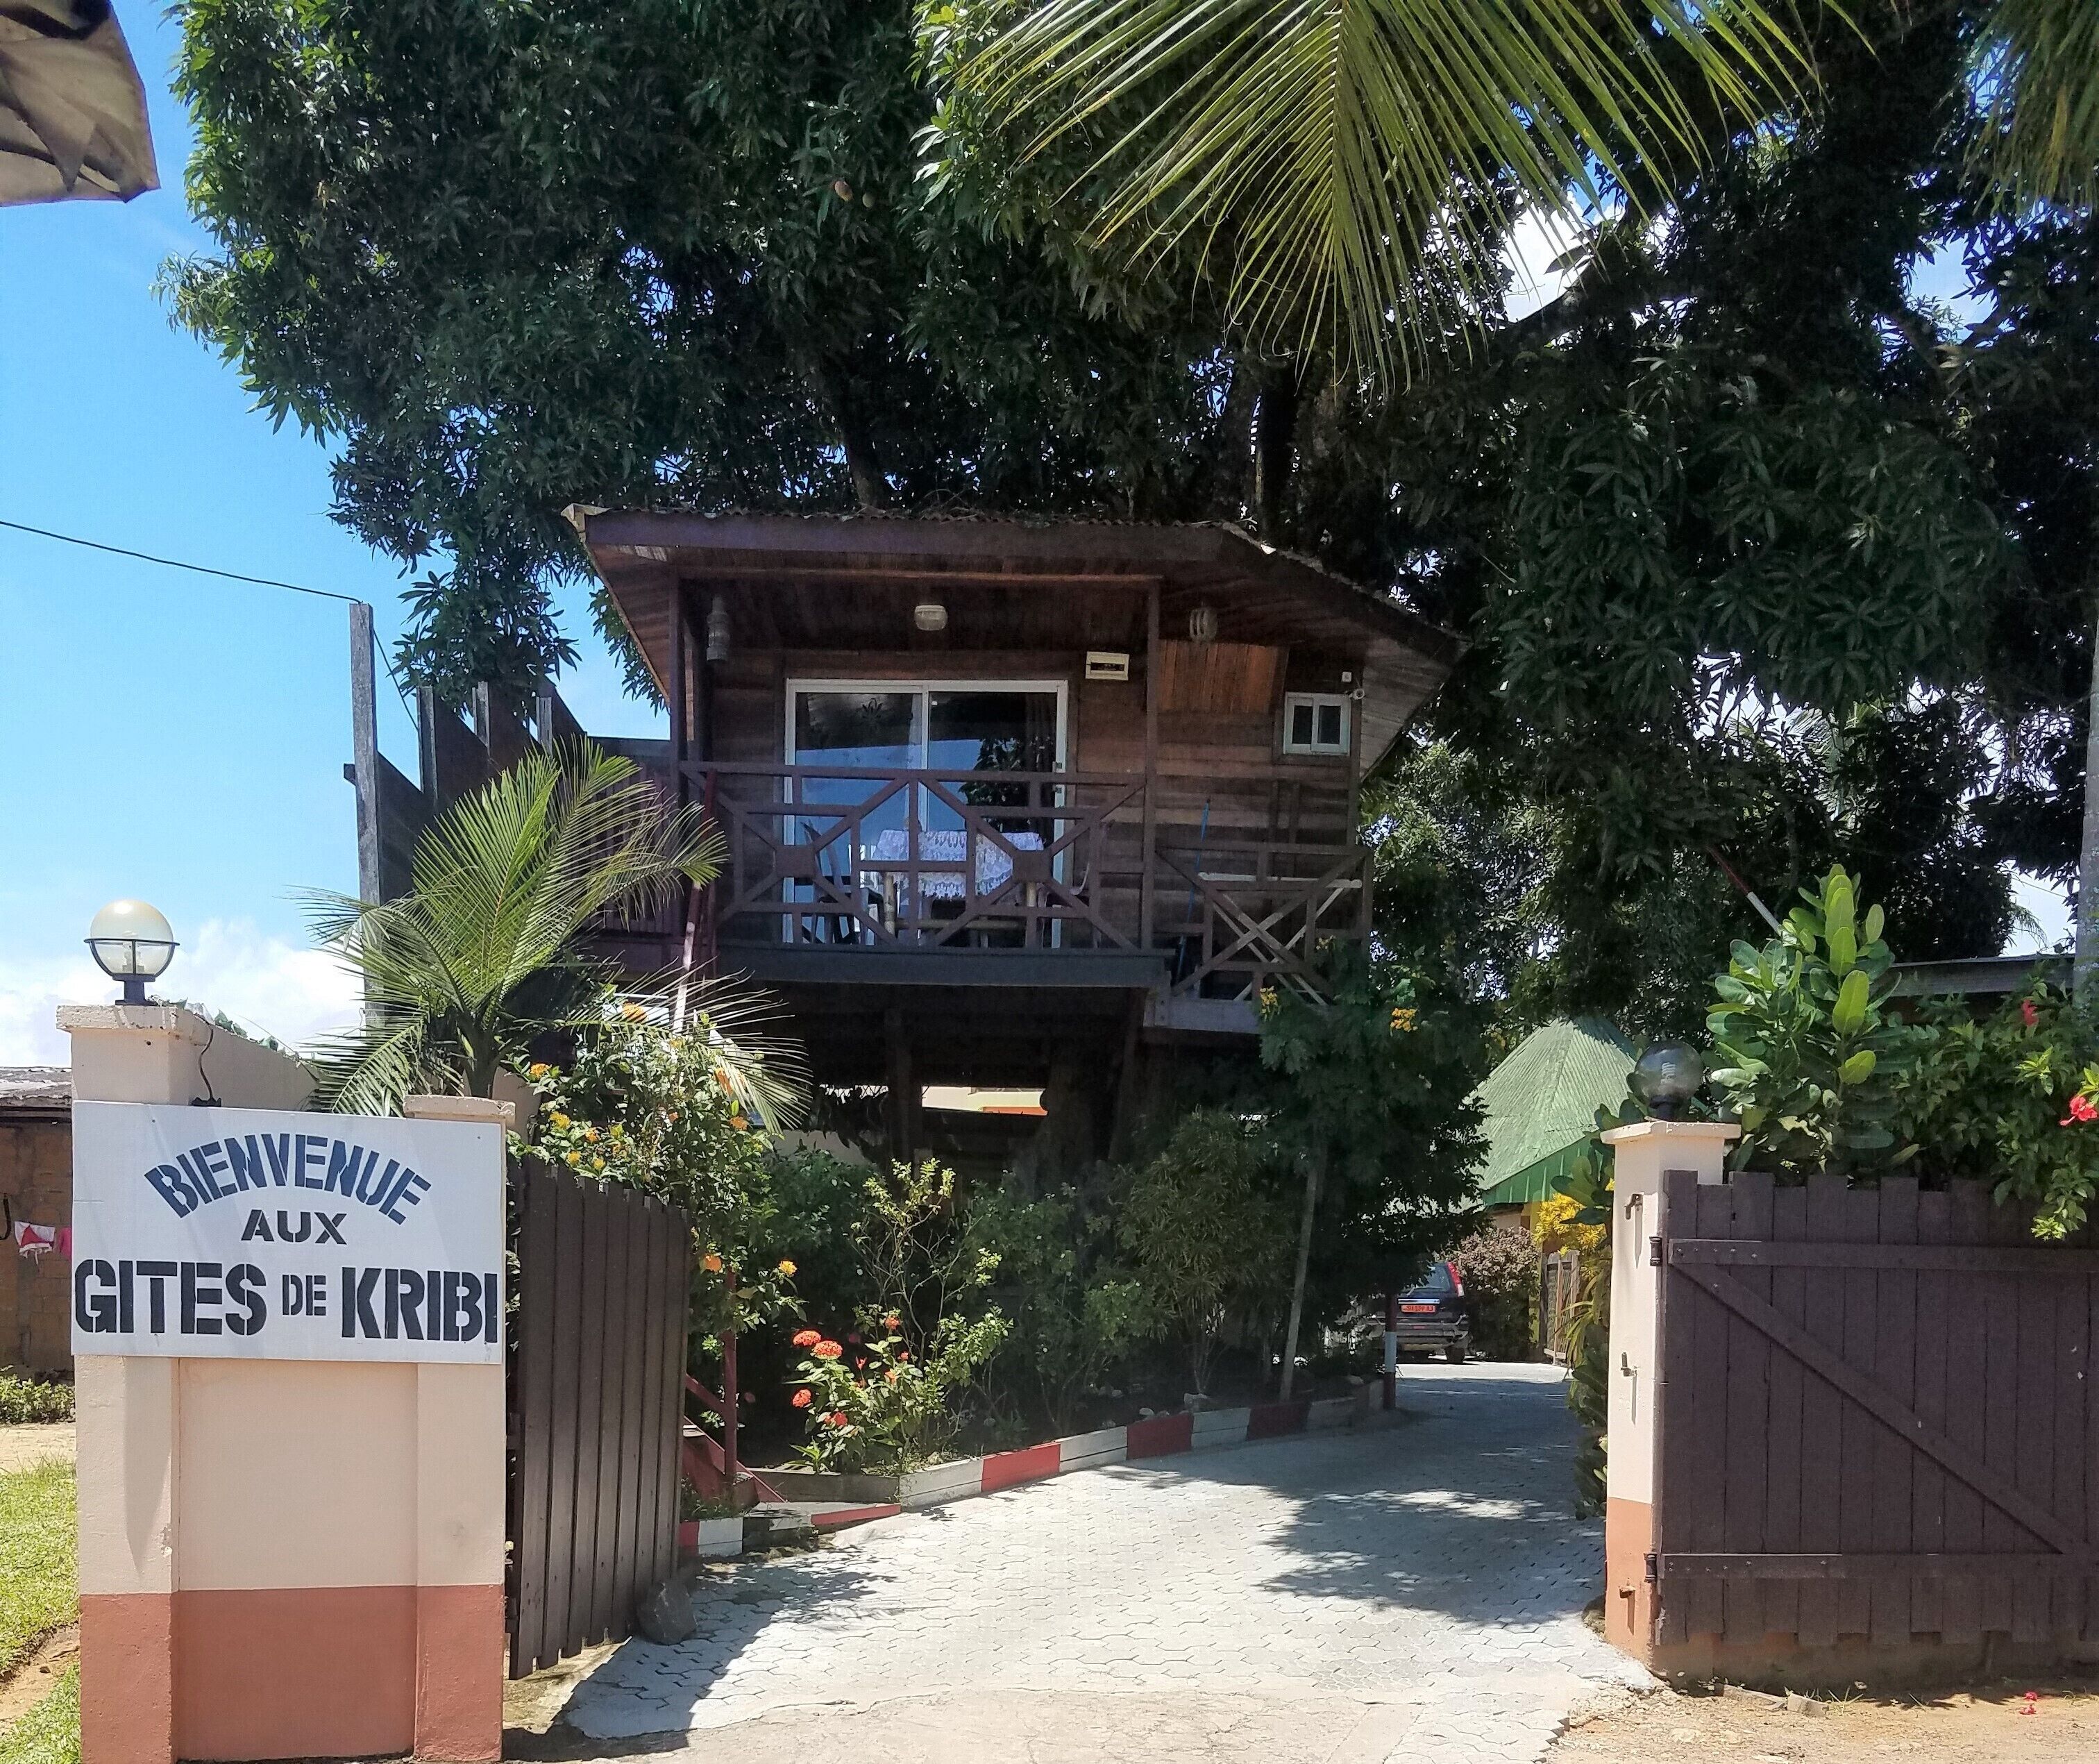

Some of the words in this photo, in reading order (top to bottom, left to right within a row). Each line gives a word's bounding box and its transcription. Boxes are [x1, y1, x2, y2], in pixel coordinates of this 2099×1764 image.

[144, 1134, 432, 1225] BIENVENUE
[241, 1209, 348, 1245] AUX
[74, 1259, 267, 1336] GITES
[283, 1275, 326, 1316] DE
[342, 1267, 498, 1343] KRIBI
